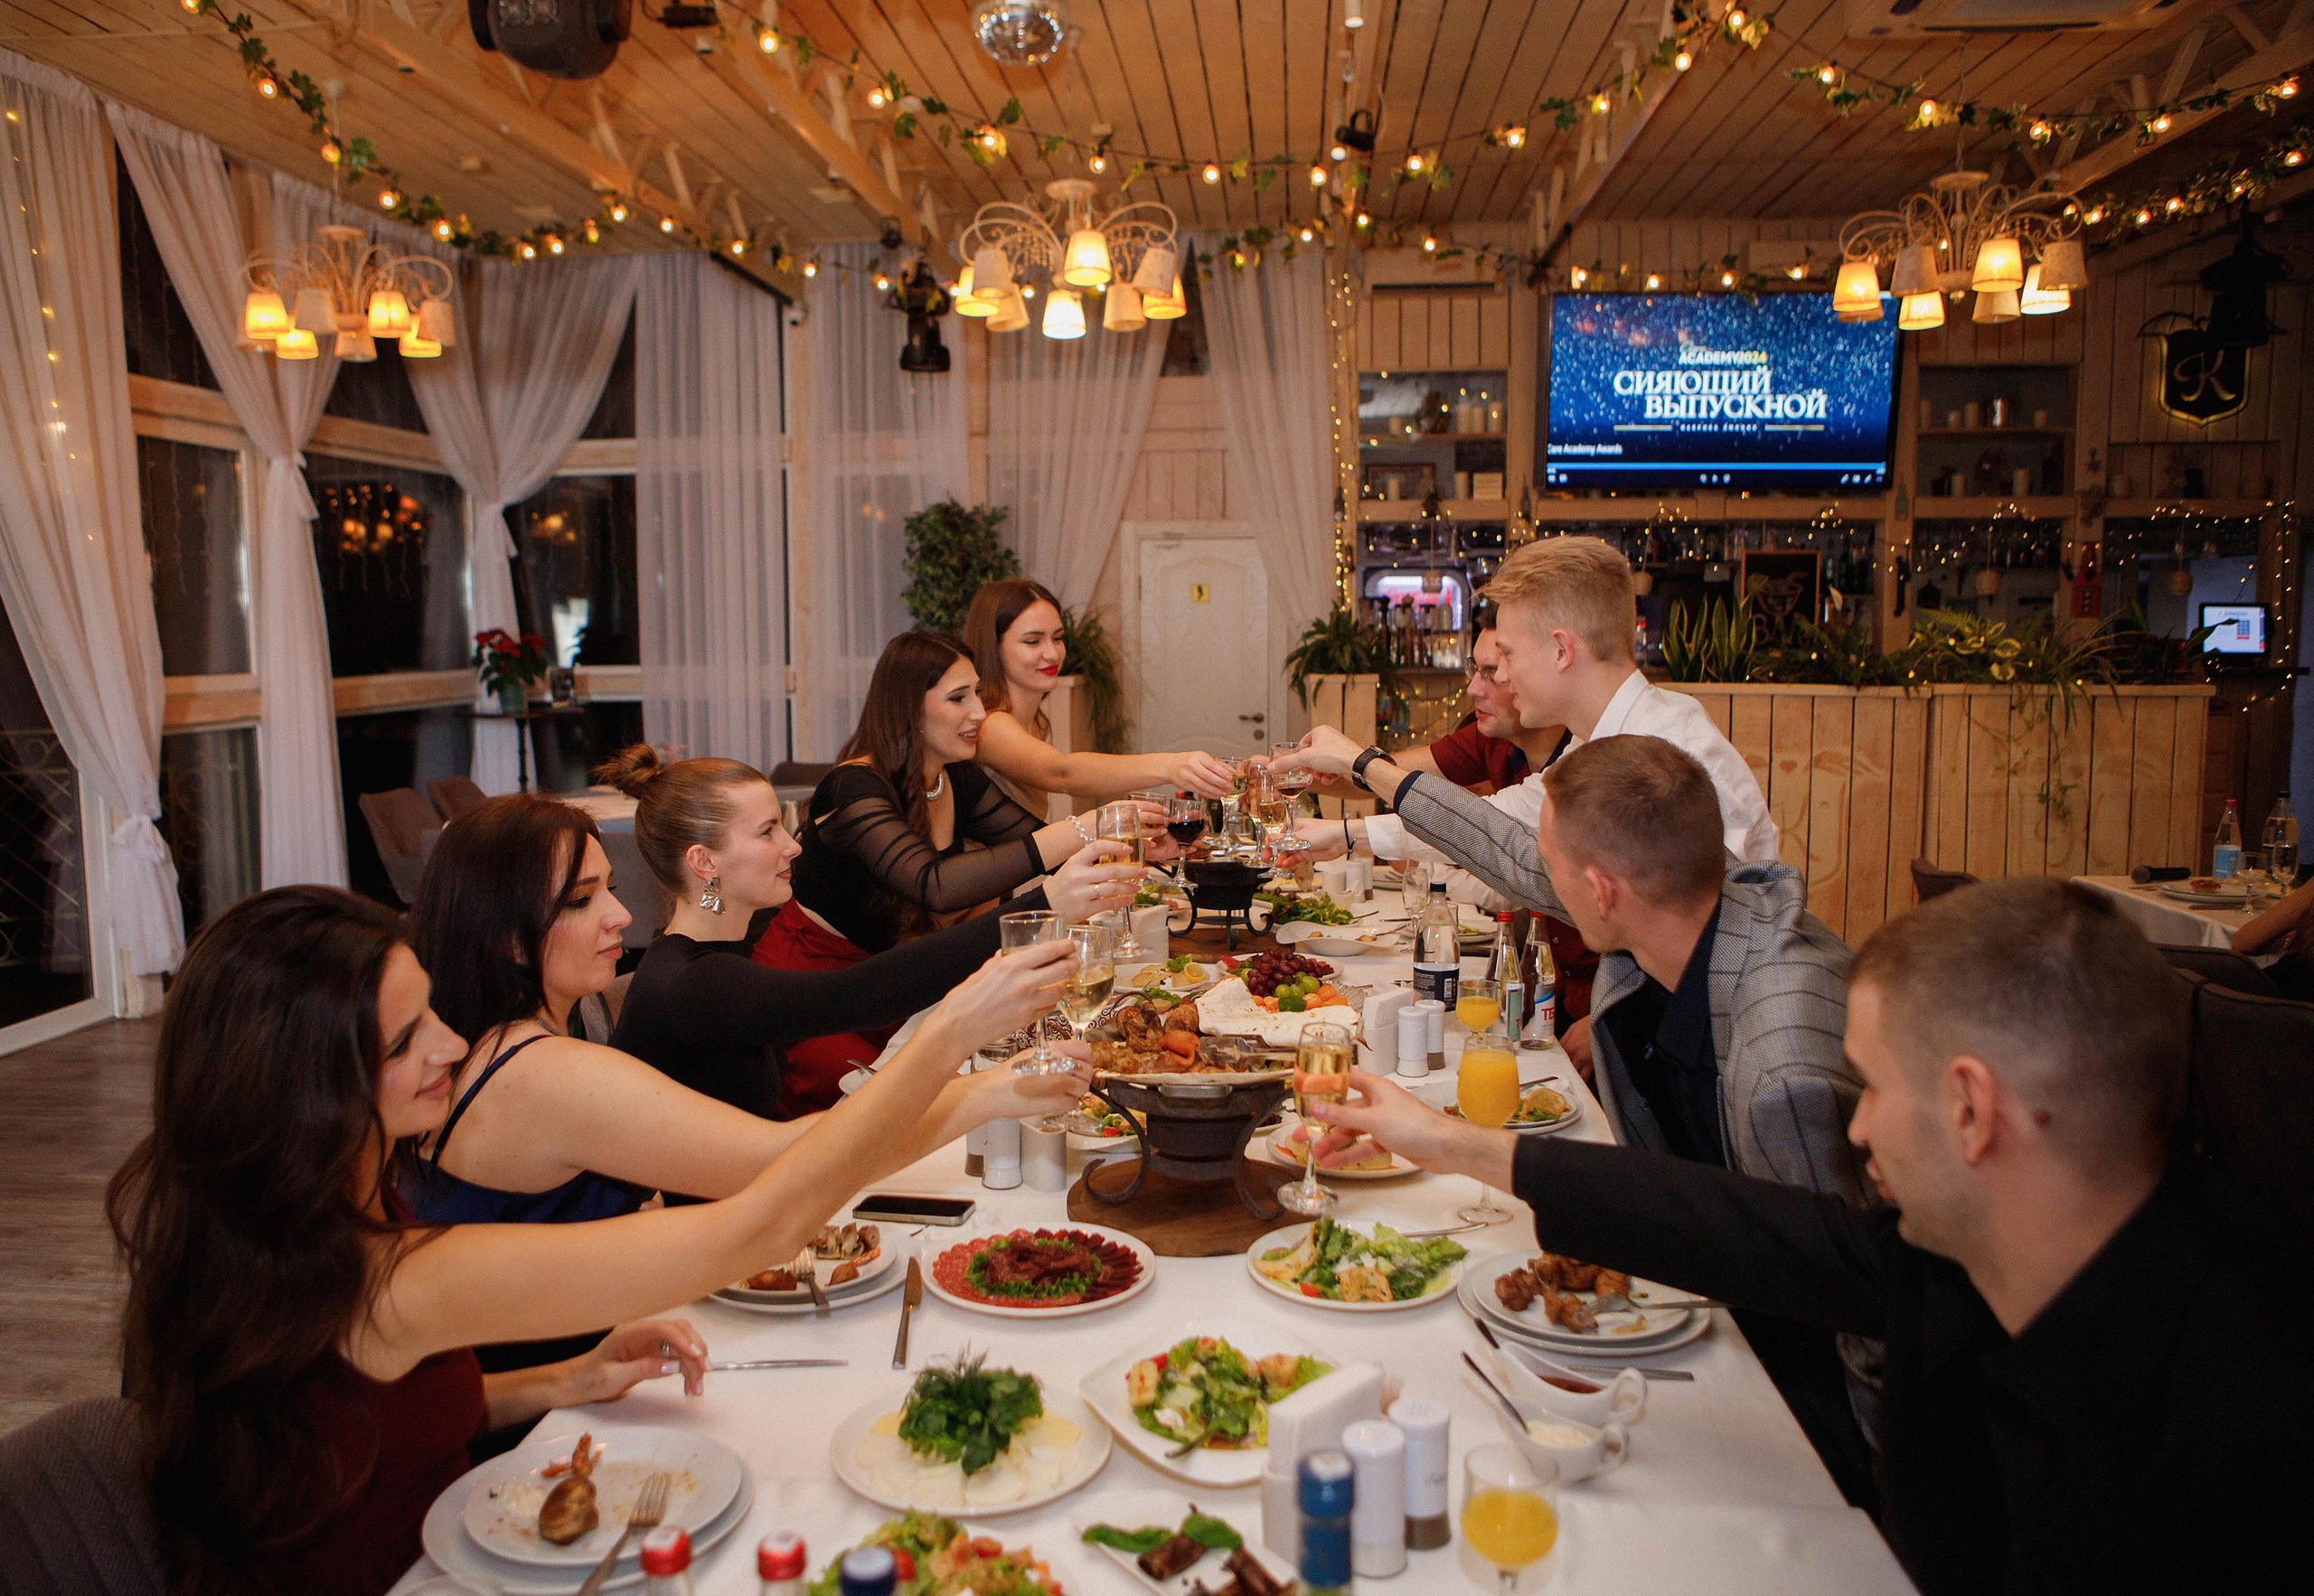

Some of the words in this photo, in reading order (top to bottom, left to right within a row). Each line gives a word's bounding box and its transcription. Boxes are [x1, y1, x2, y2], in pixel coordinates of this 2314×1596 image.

[1613, 365, 1773, 397] СИЯЮЩИЙ
[1644, 388, 1828, 419] ВЫПУСКНОЙ
[1563, 443, 1596, 456] Academy
